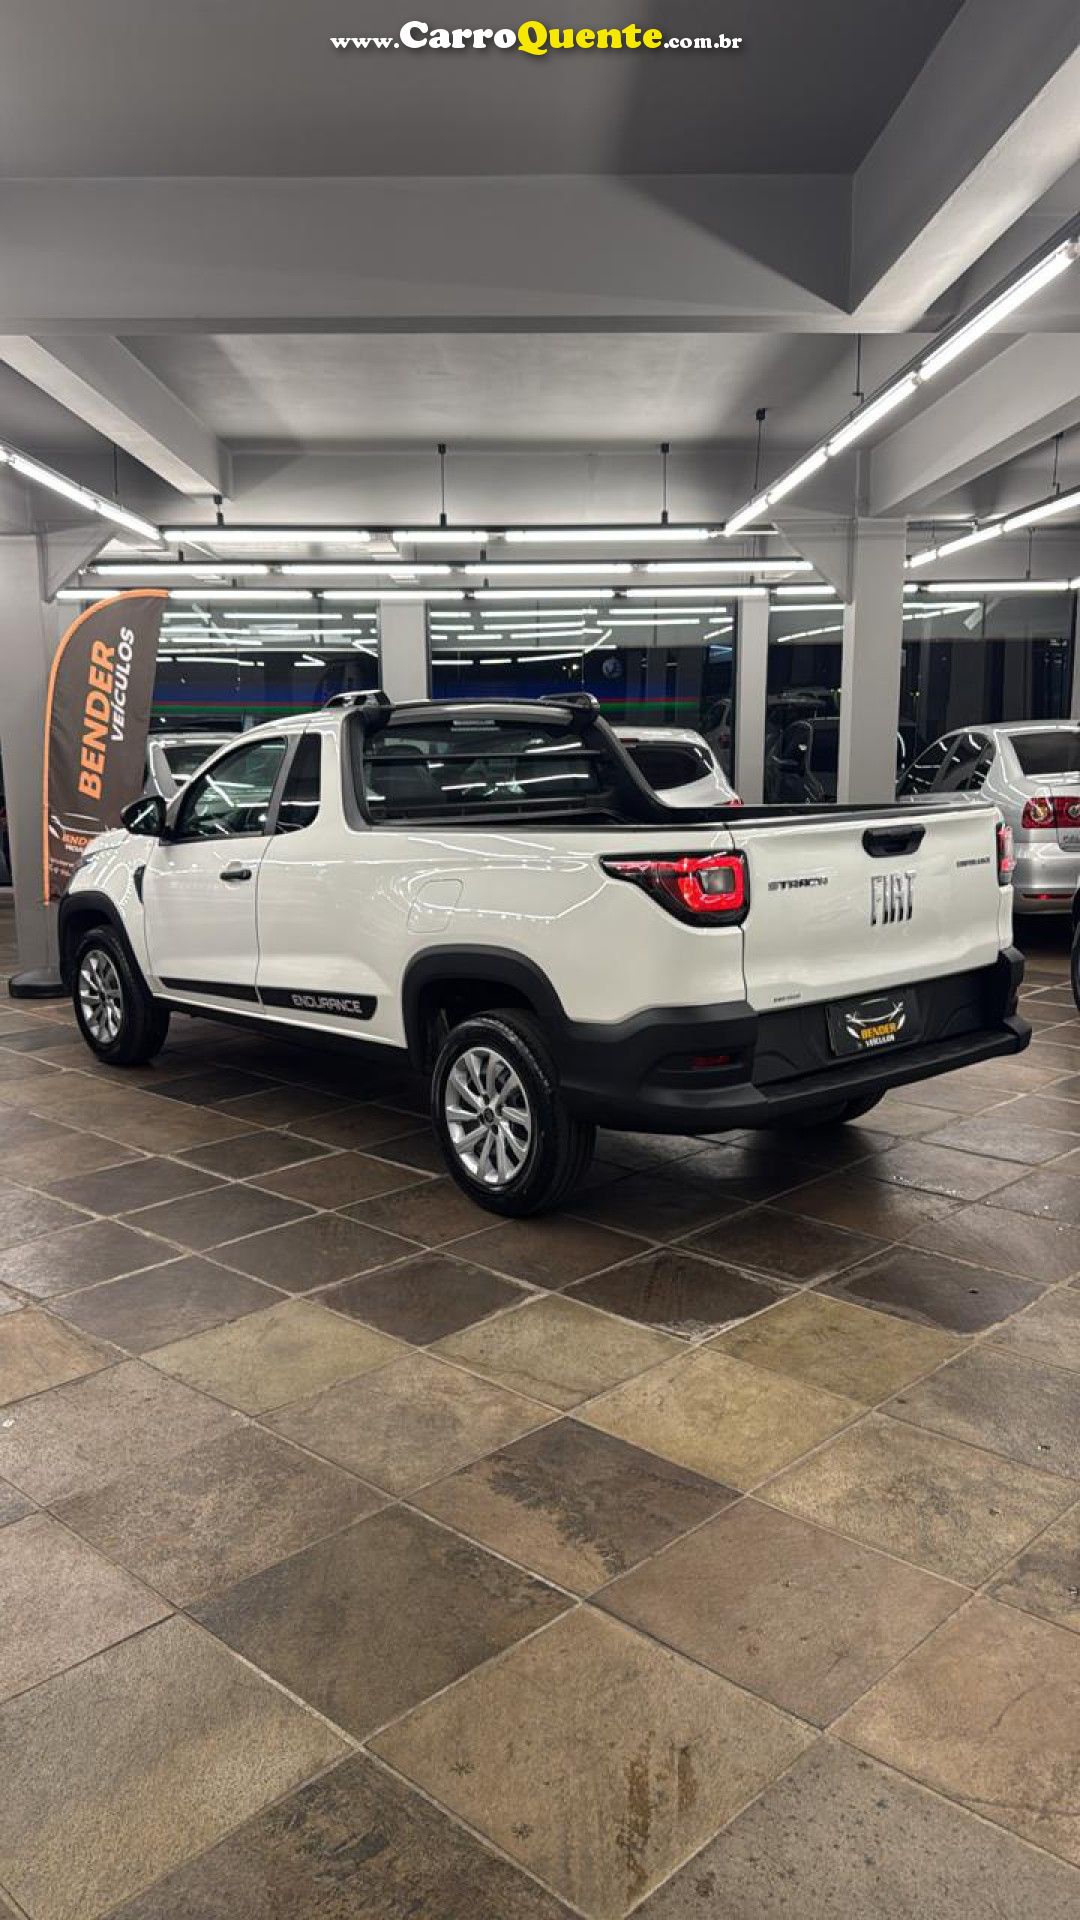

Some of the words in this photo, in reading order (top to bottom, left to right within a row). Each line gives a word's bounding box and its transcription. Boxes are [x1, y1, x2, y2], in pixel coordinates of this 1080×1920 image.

[78, 640, 115, 800] BENDER
[111, 626, 135, 742] VEÍCULOS
[871, 871, 916, 927] FIAT
[291, 993, 362, 1014] ENDURANCE
